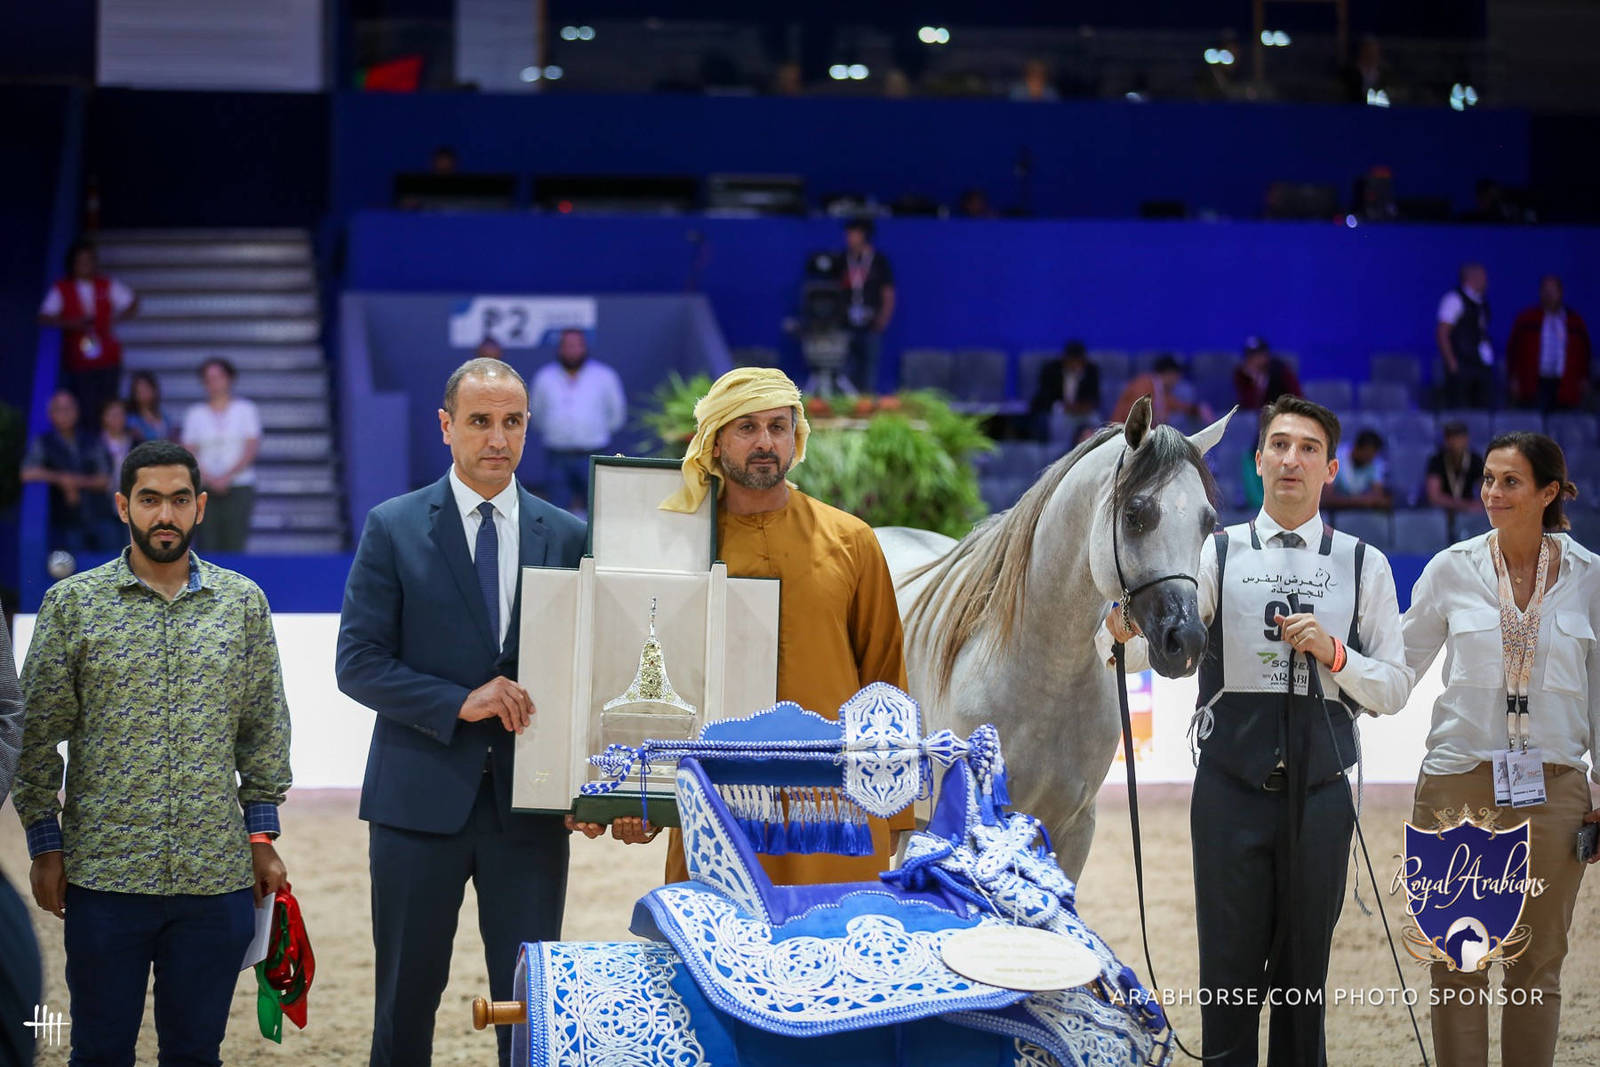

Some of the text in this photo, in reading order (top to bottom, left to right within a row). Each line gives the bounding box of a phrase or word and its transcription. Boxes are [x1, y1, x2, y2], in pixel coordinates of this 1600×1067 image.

[1242, 574, 1323, 587] معرض الفرس
[1264, 601, 1314, 641] 9
